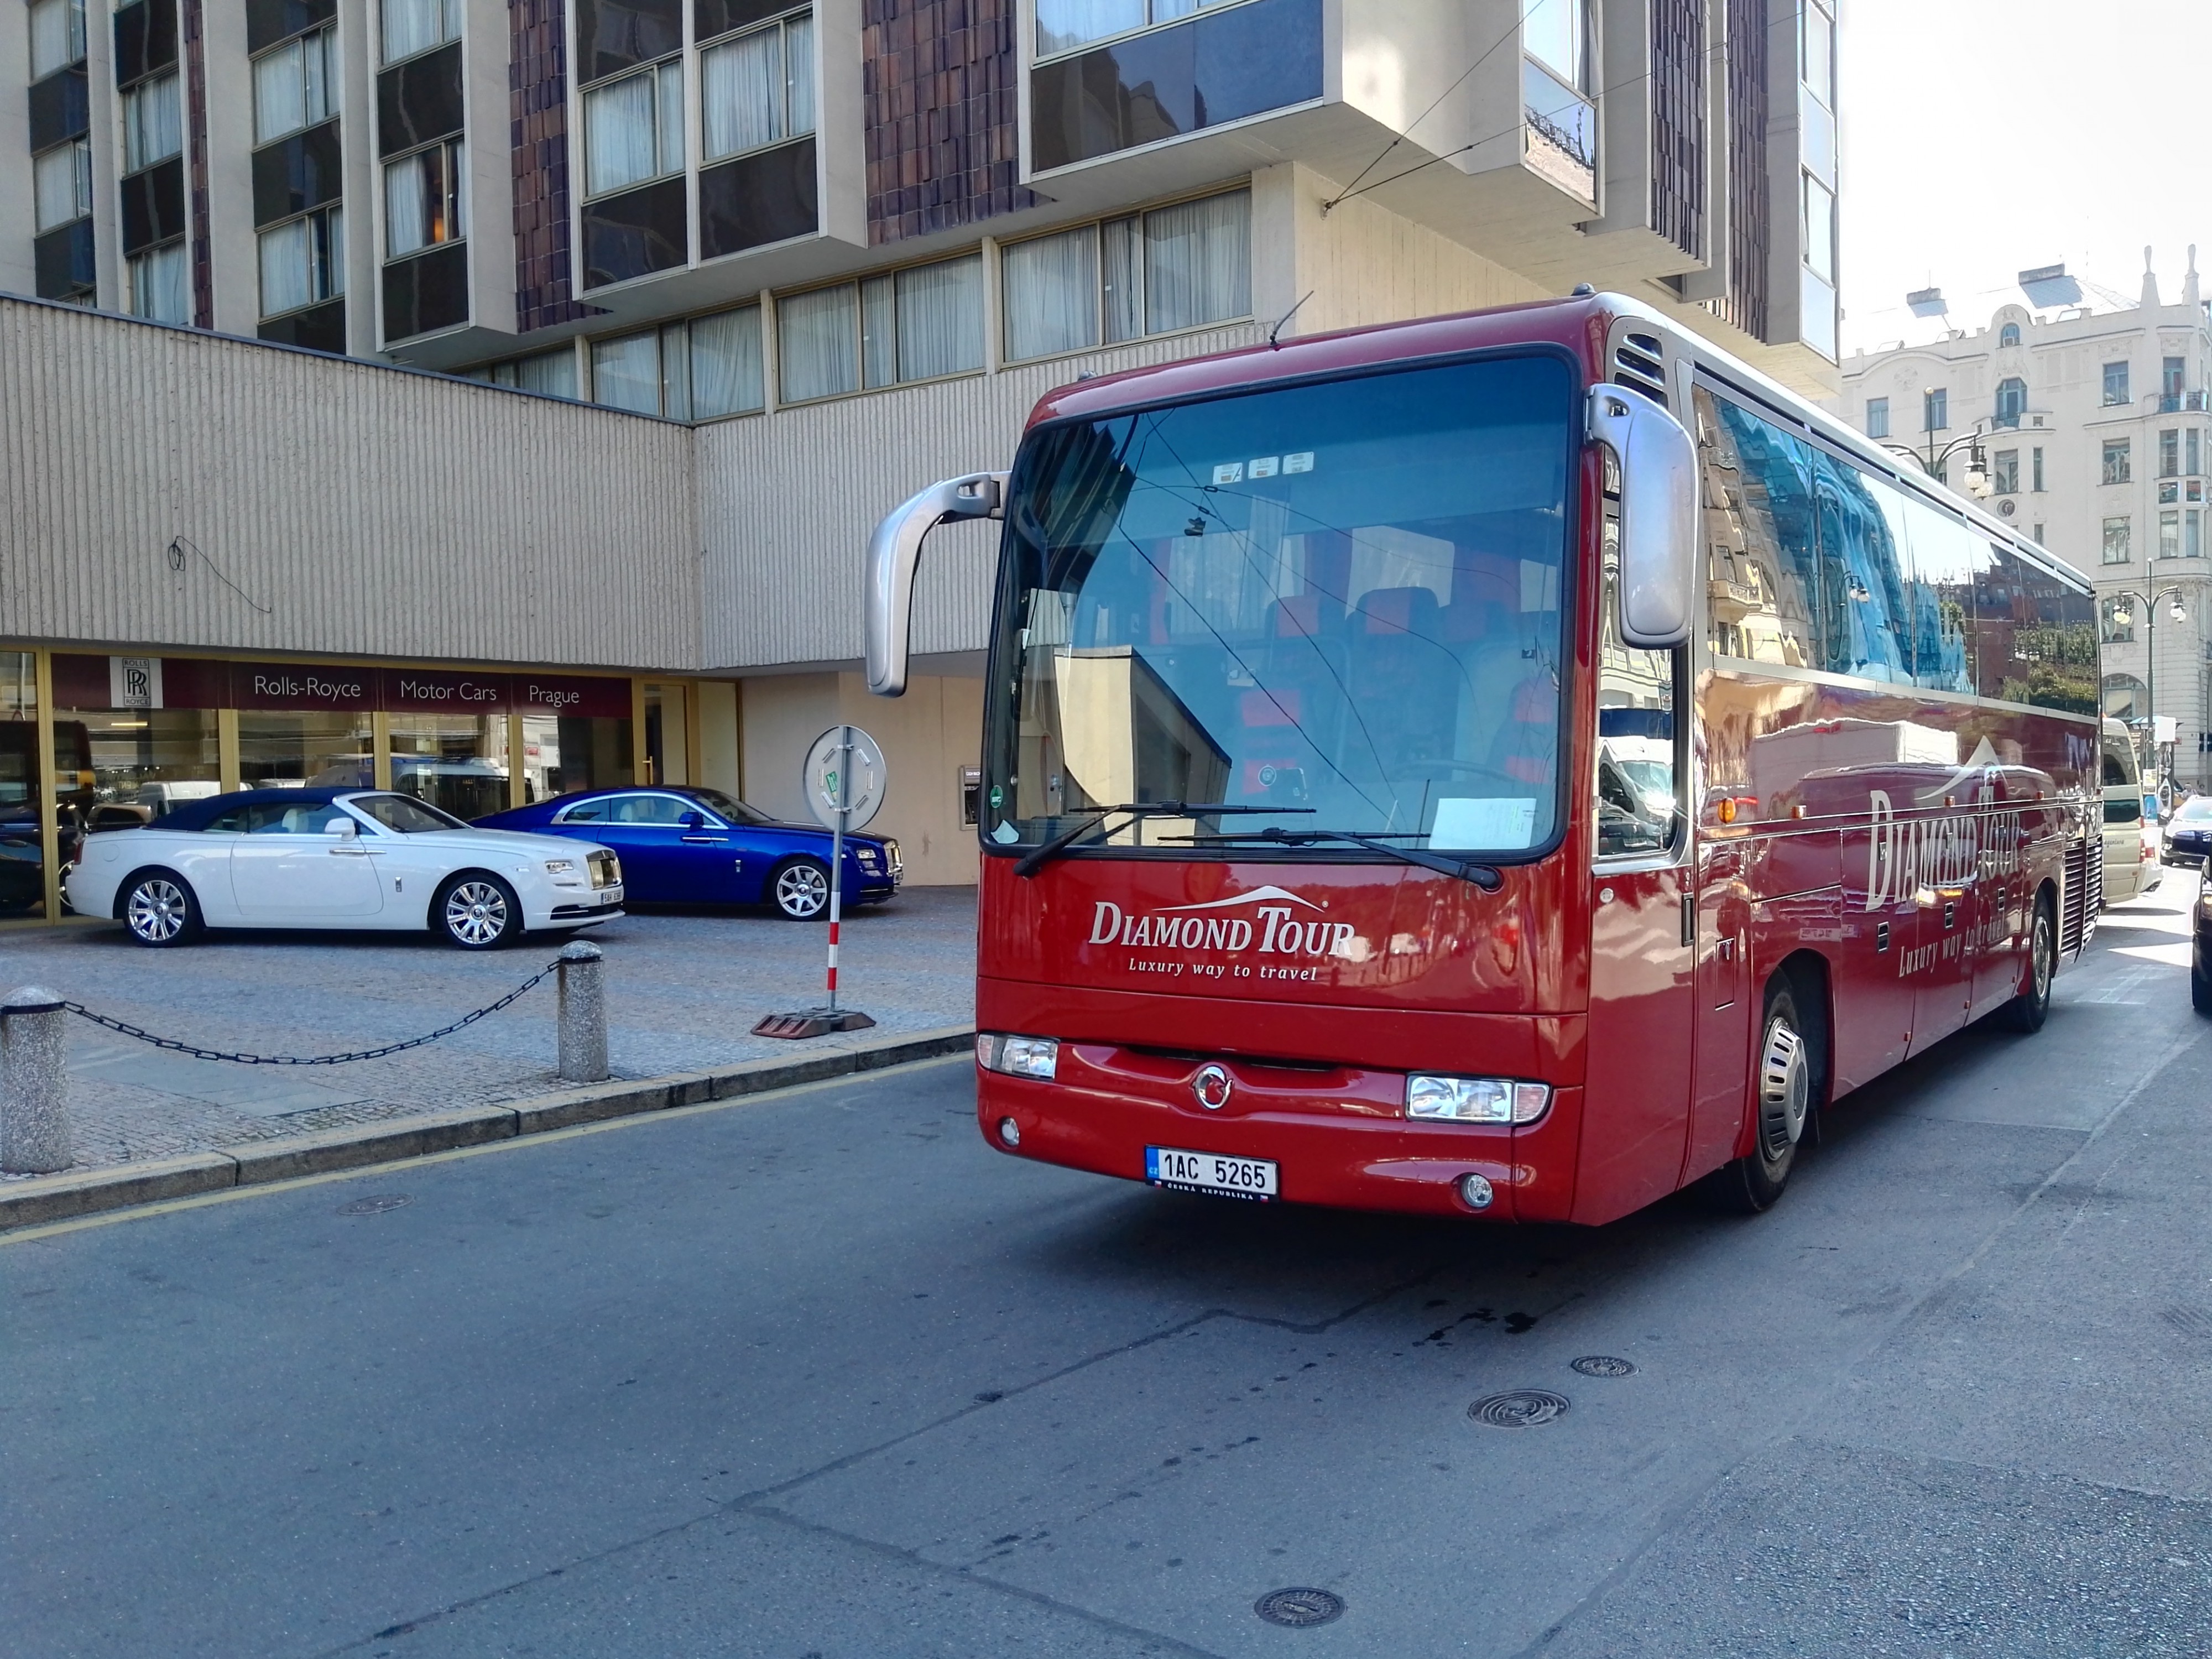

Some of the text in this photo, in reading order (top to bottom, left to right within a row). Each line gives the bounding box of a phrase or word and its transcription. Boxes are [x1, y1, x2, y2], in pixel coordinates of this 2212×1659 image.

[255, 676, 580, 707] Rolls-Royce Motor Cars Prague
[1865, 786, 2020, 911] DIAMOND TOUR
[1089, 901, 1355, 956] DIAMOND TOUR
[1899, 915, 2005, 977] Luxury way to travel
[1129, 958, 1317, 980] Luxury way to travel
[1149, 1167, 1159, 1175] CZ
[1165, 1154, 1266, 1188] 1AC 5265
[1202, 1187, 1254, 1201] REPUBLIKA
